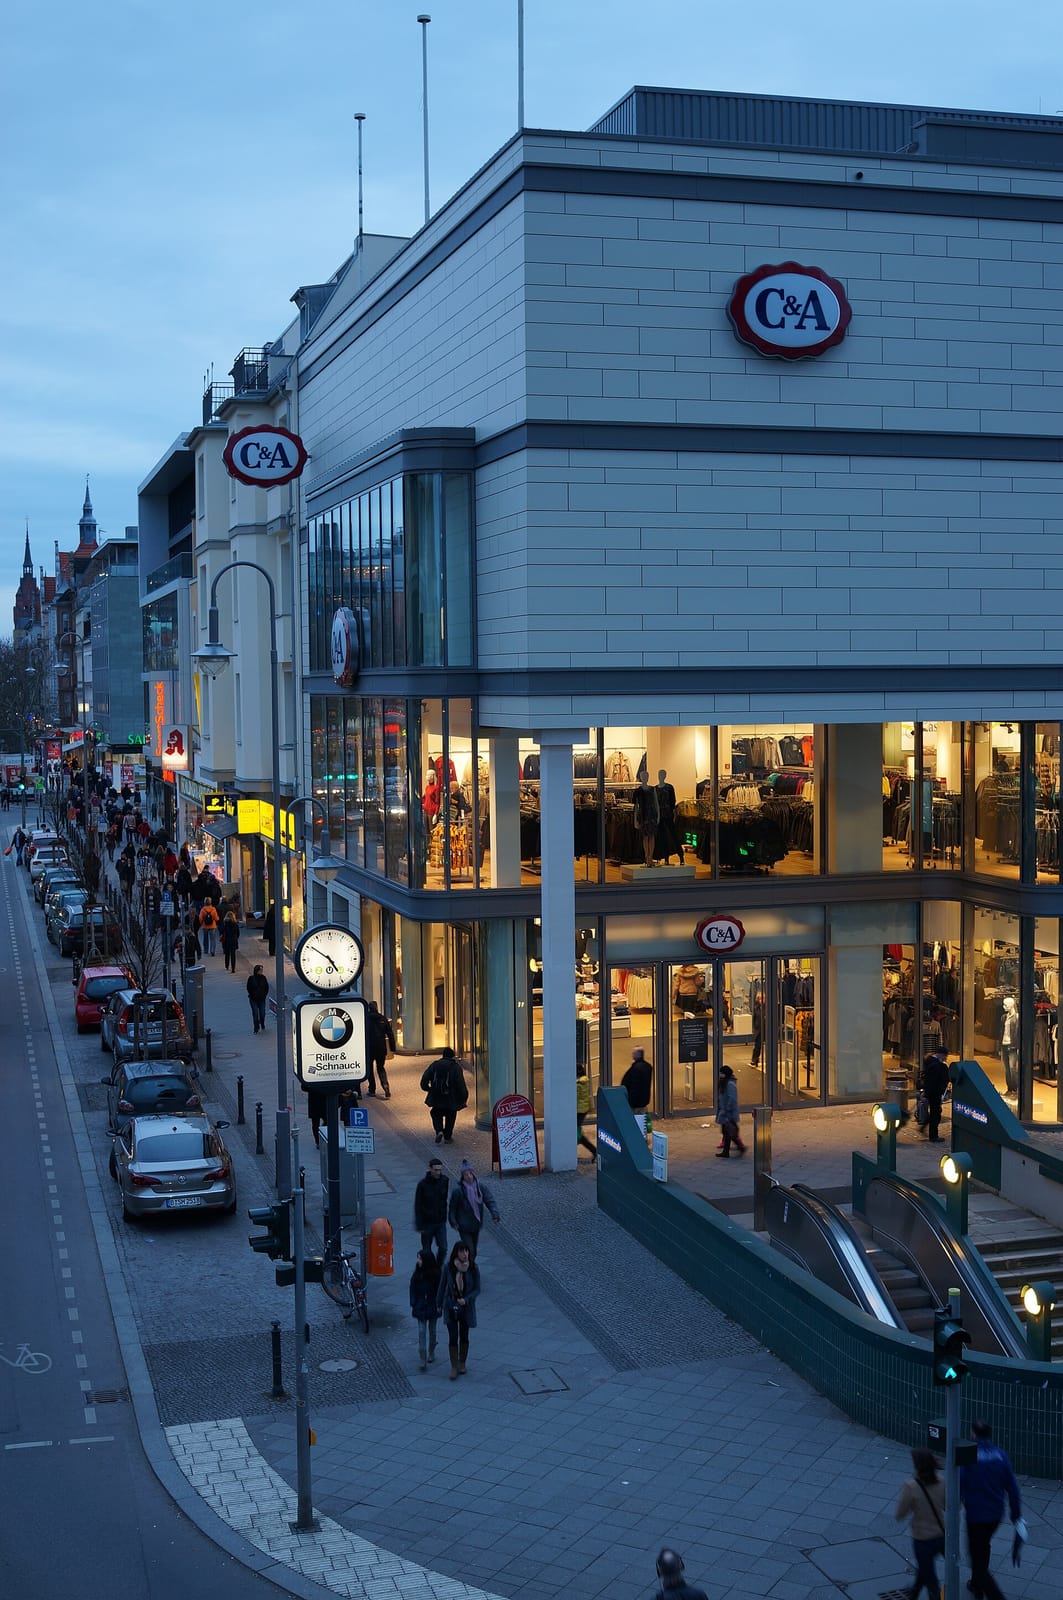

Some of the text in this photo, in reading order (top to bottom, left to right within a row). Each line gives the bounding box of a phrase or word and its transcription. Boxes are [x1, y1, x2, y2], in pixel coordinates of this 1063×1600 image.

[755, 288, 831, 331] C&A
[240, 441, 293, 469] C&A
[706, 926, 737, 944] C&A
[315, 1008, 351, 1023] BMW
[315, 1052, 347, 1062] Riller &
[315, 1061, 361, 1071] Schnauck
[353, 1110, 364, 1125] P
